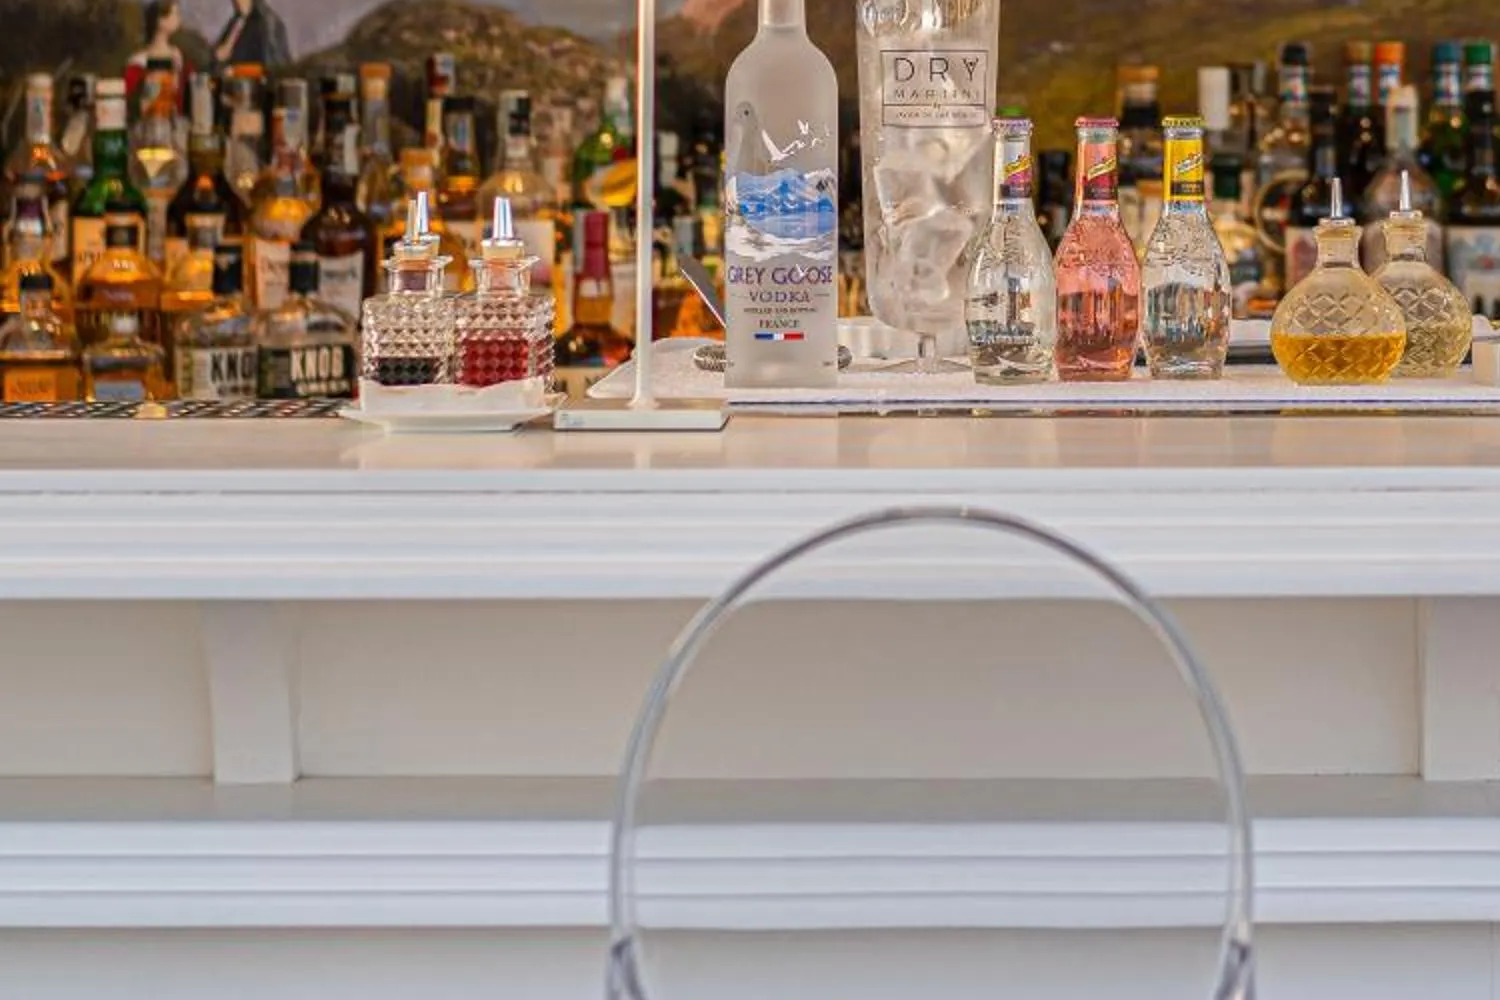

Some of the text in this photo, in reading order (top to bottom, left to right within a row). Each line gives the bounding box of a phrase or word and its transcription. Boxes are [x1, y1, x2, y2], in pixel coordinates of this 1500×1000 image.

[894, 57, 980, 82] DRY
[728, 265, 832, 284] GREY GOOSE
[749, 291, 810, 302] VODKA
[759, 319, 800, 328] FRANCE
[211, 351, 255, 383] KNO
[291, 346, 344, 381] KNOB
